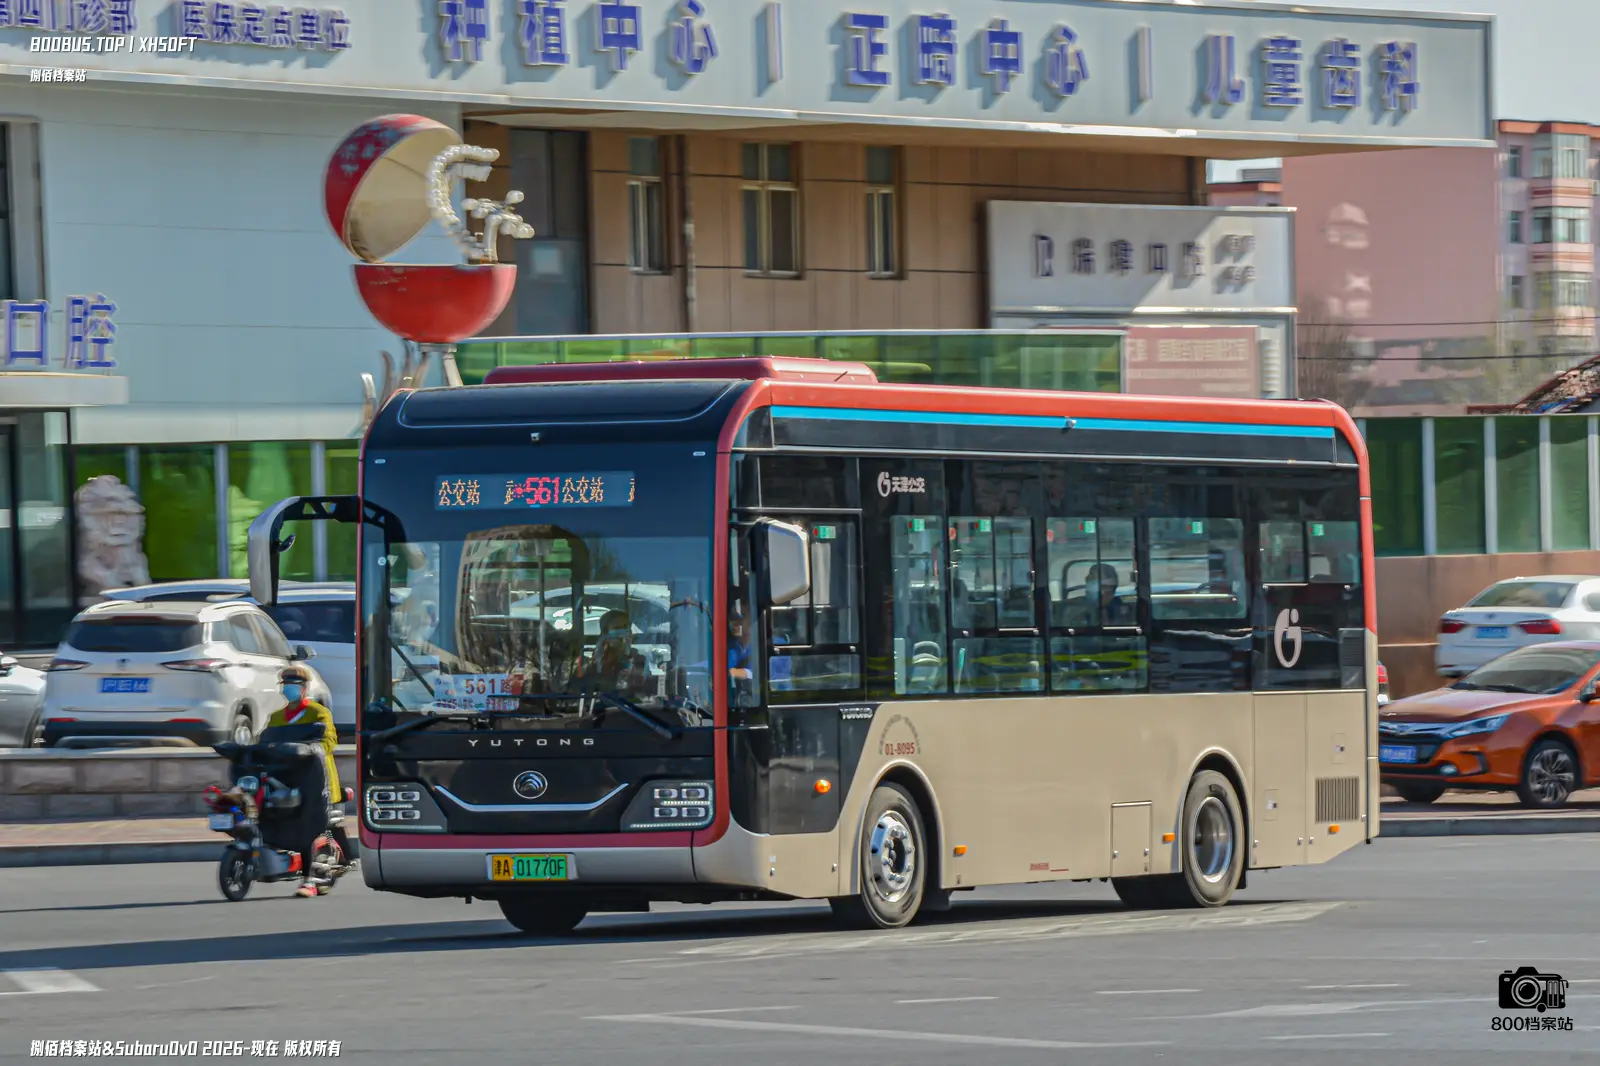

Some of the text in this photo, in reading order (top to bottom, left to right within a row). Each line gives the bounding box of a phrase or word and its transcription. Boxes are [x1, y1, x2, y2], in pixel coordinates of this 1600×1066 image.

[182, 0, 352, 51] 医保定点单位
[438, 0, 1421, 112] 种植中心 正畸中心 儿童齿科
[3, 292, 118, 369] 口腔
[438, 479, 480, 506] 公交站
[525, 476, 560, 505] 561
[562, 476, 604, 504] 公交站
[468, 738, 595, 747] YUTONG
[884, 742, 916, 756] 01-8095
